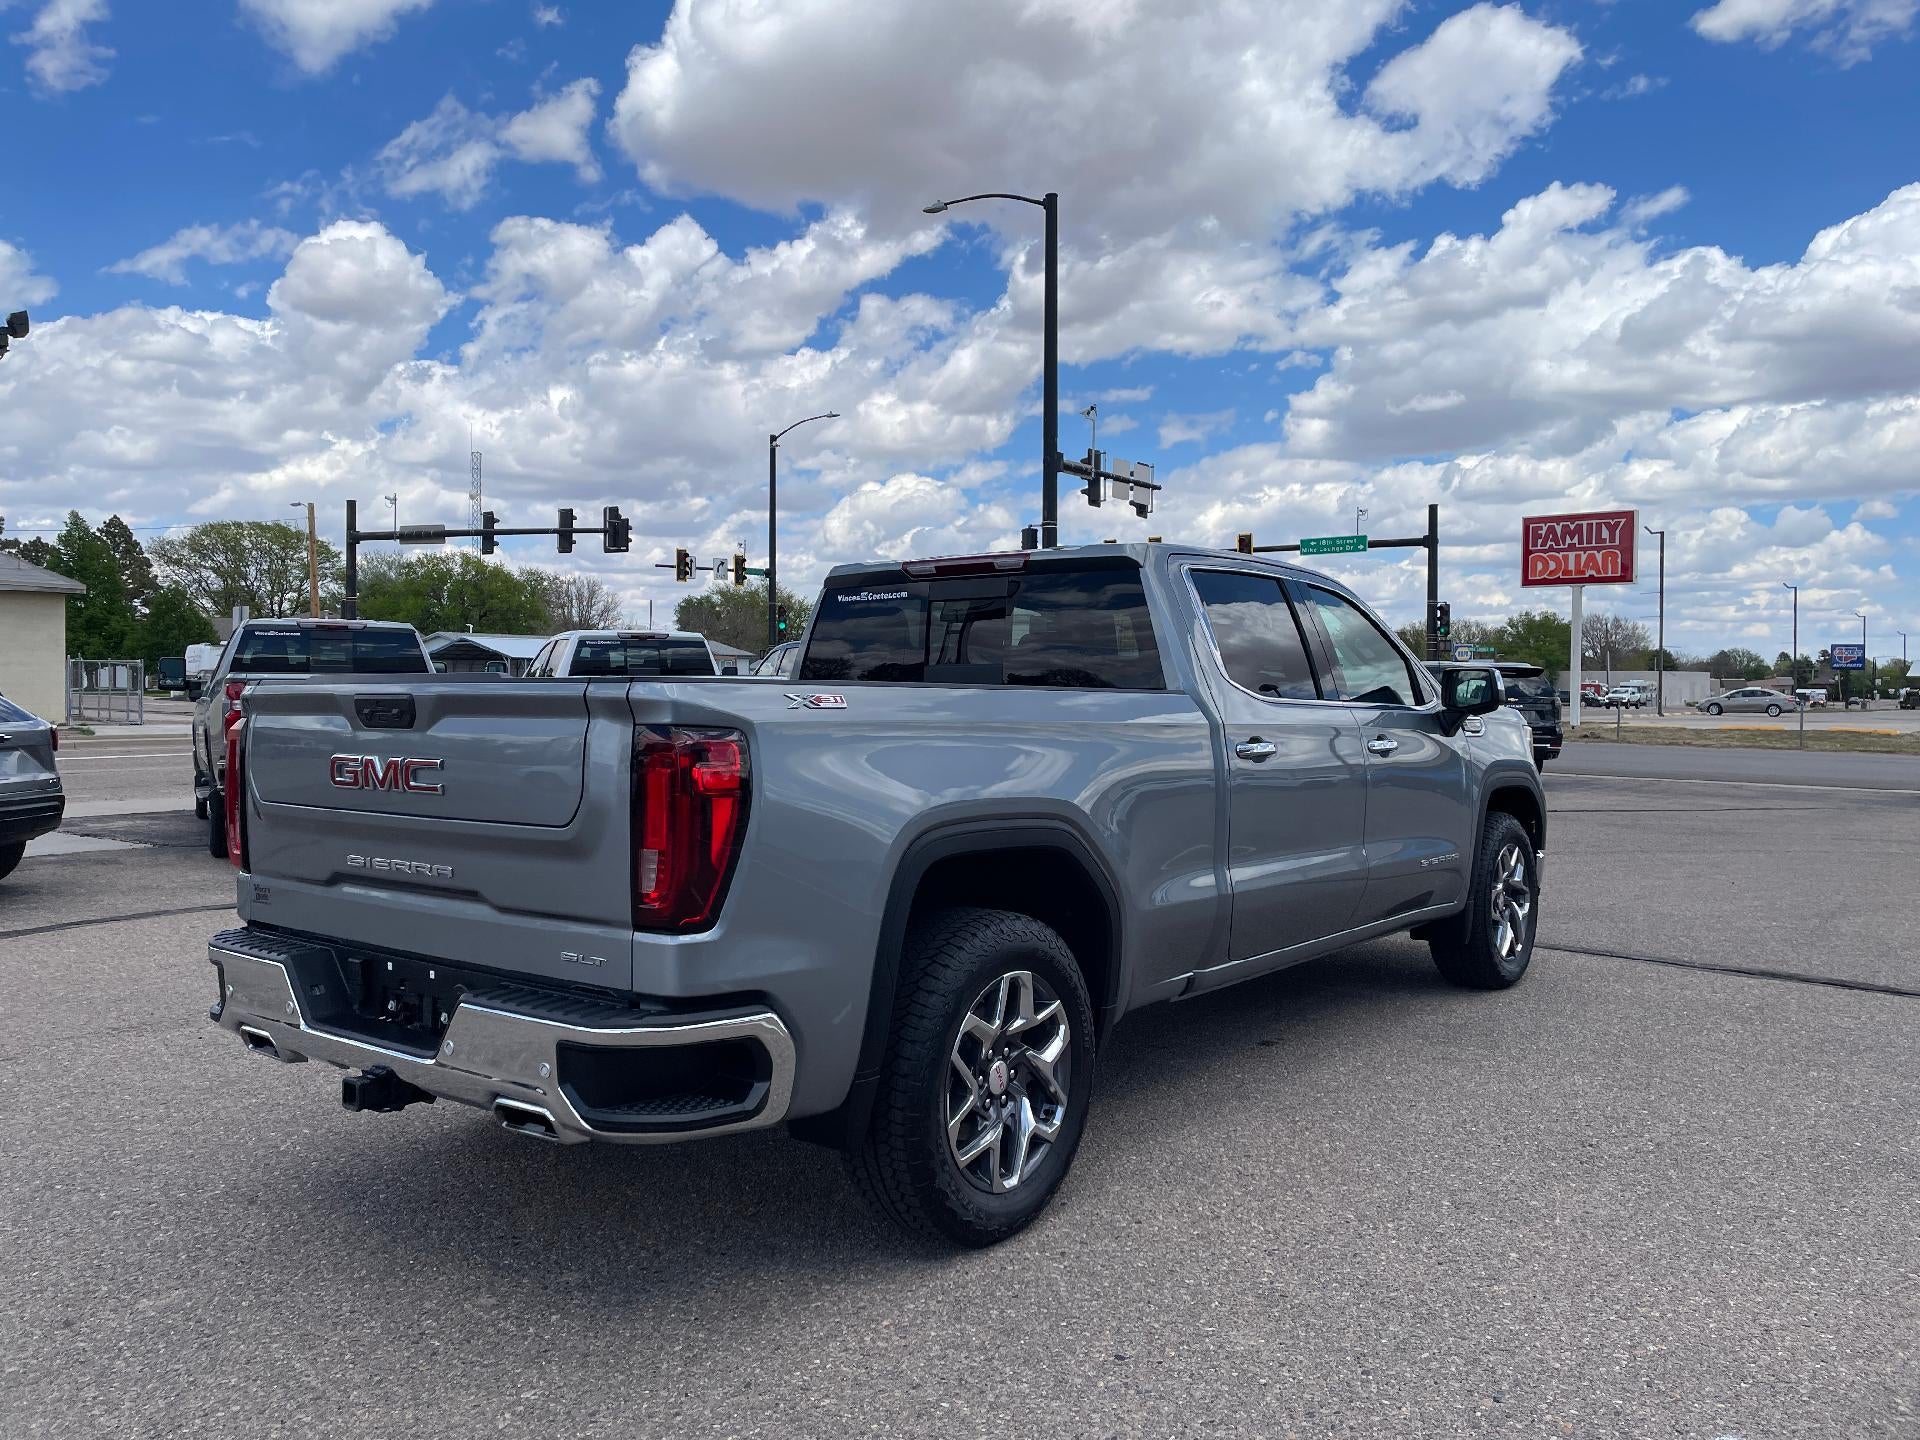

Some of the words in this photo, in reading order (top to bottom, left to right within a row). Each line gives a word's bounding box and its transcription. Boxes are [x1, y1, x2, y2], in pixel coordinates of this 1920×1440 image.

[1529, 518, 1626, 550] FAMILY
[1528, 549, 1622, 579] DOLLAR
[330, 753, 446, 795] GMC
[346, 854, 455, 879] SIERRA
[560, 951, 608, 968] SLT
